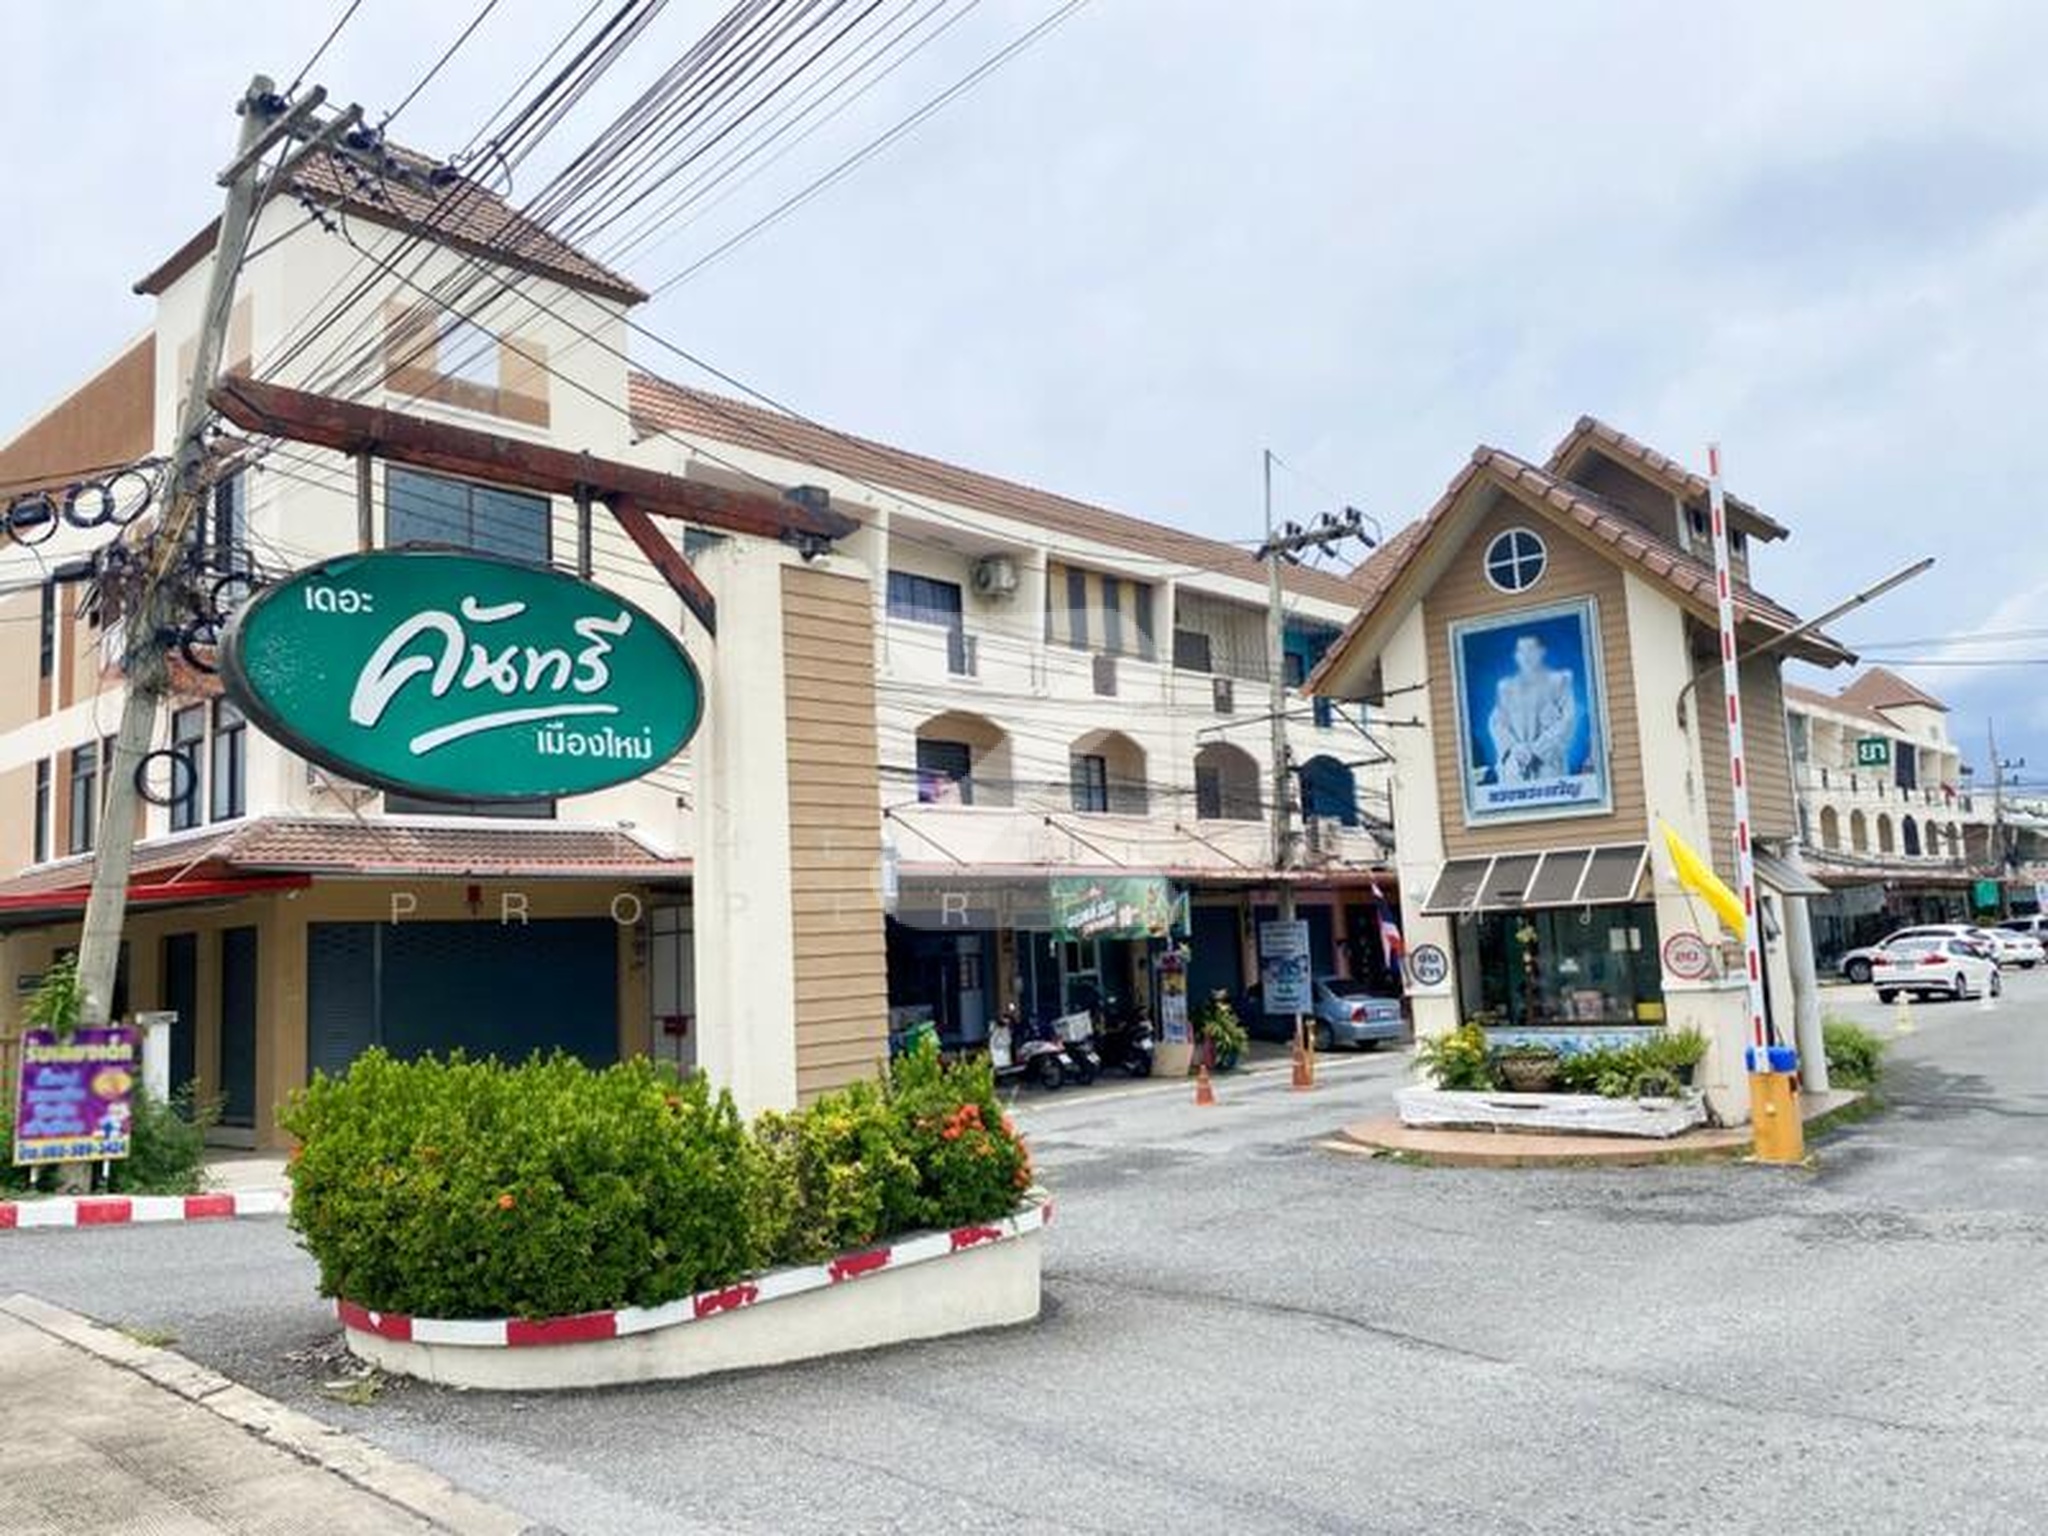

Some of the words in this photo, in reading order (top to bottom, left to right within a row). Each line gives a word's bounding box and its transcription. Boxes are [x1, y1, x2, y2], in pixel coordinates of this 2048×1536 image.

[305, 586, 373, 613] เดอะ
[349, 596, 632, 727] คันทรี
[537, 722, 652, 759] เมืองใหม่
